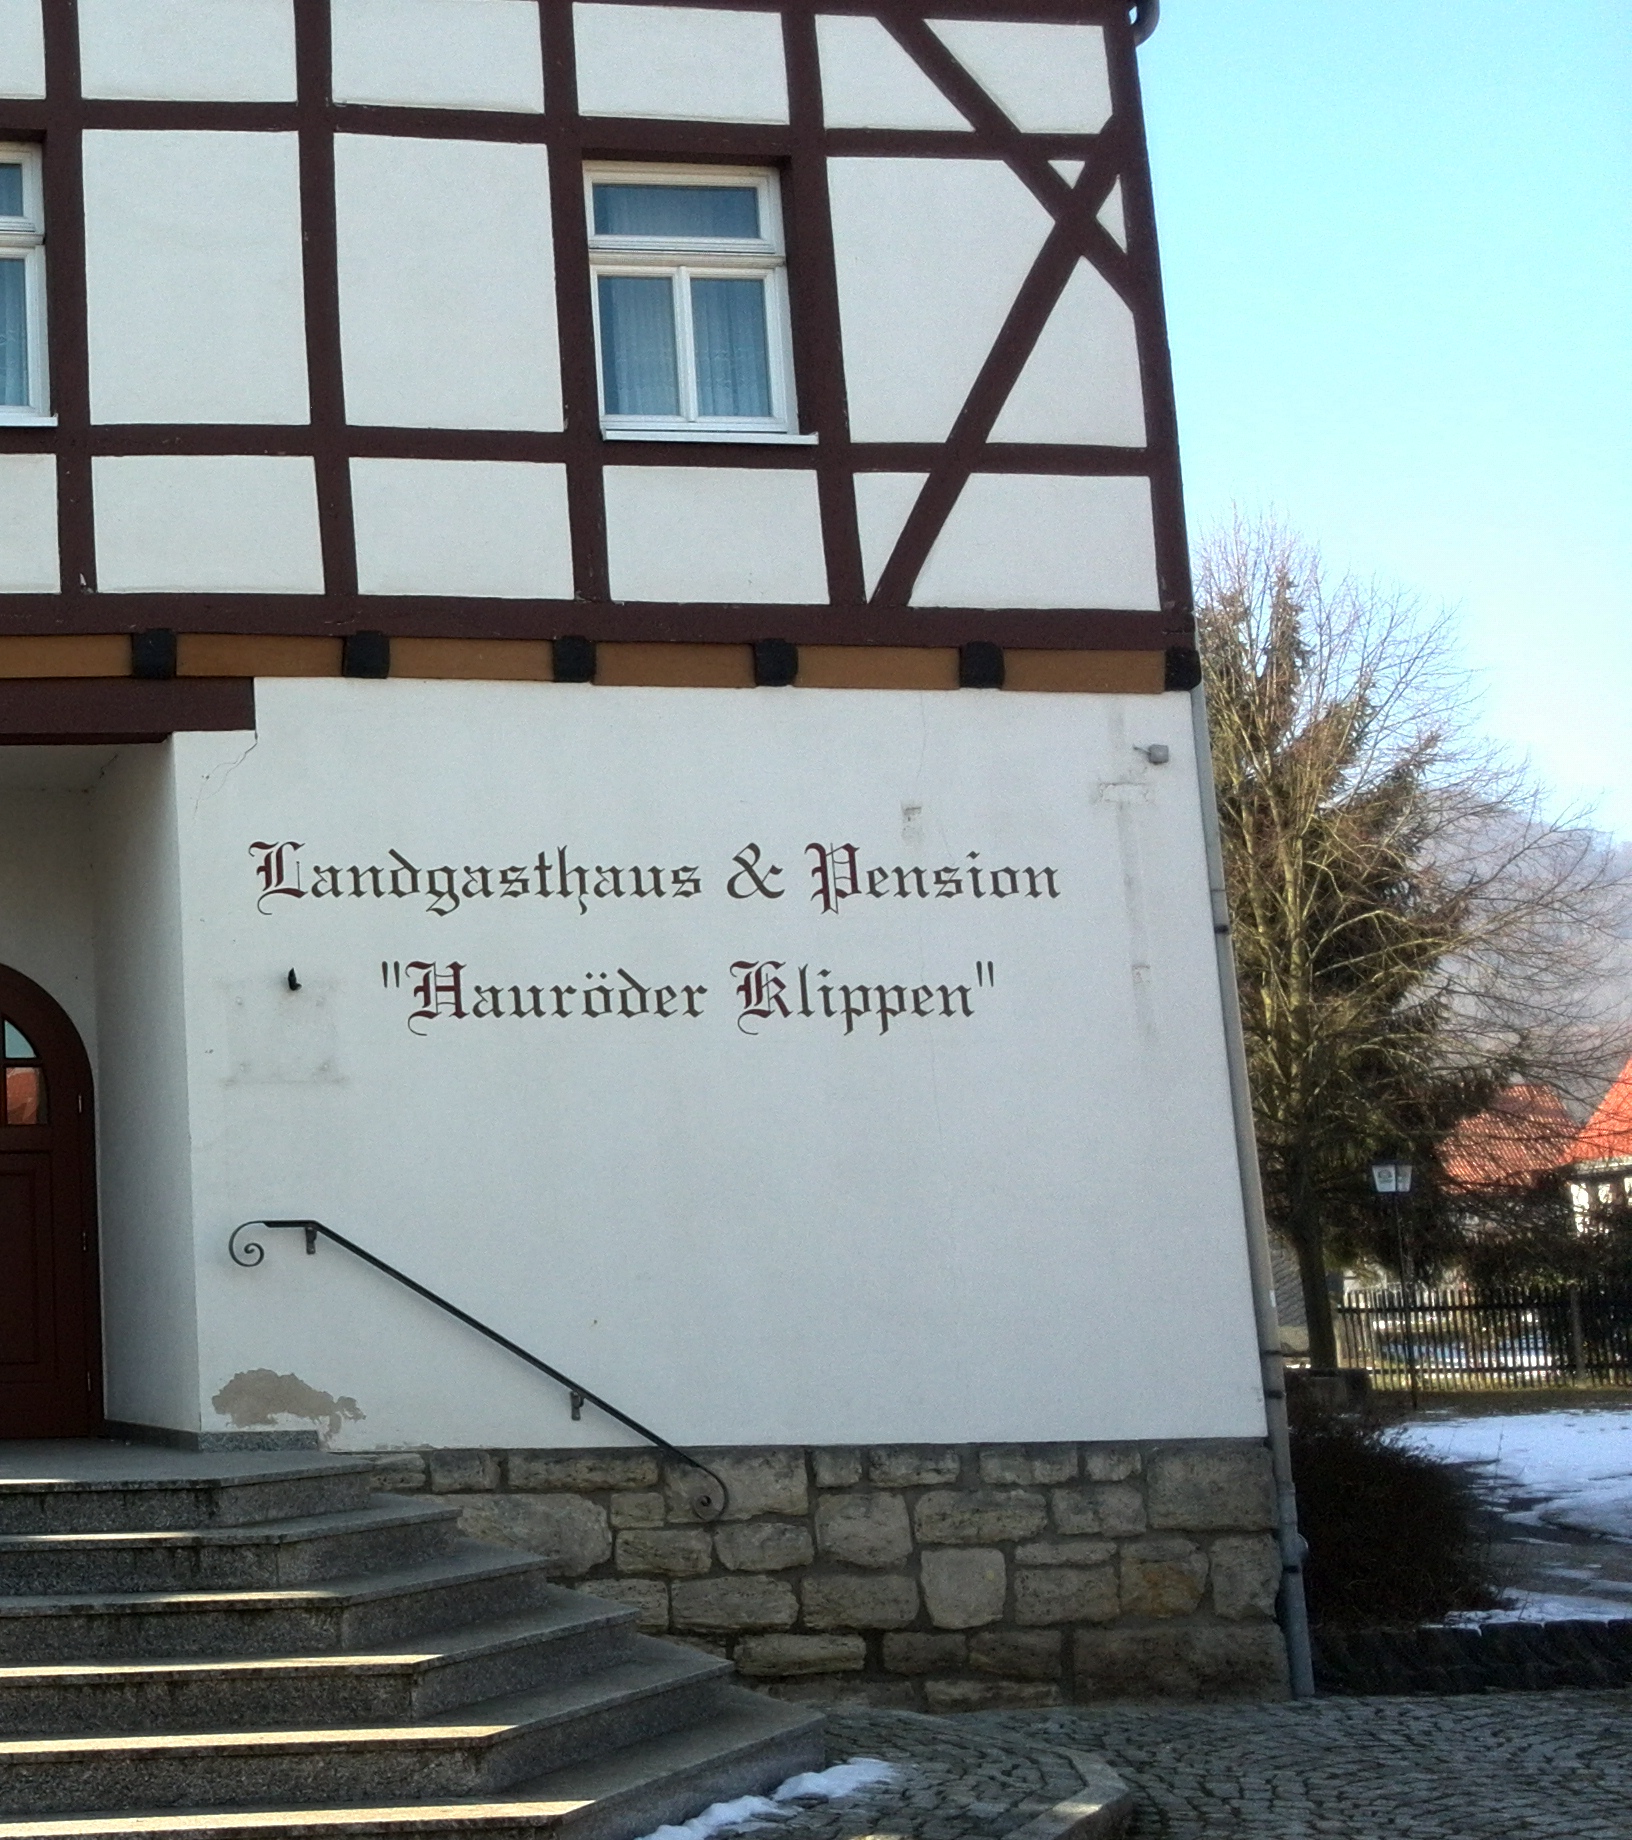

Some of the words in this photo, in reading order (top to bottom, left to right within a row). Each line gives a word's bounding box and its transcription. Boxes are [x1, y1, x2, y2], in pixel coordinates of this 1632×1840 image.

[248, 841, 702, 916] Landgasthaus
[726, 842, 785, 899] &
[804, 842, 1061, 915] Pension
[382, 961, 708, 1036] "Hauröder
[729, 960, 995, 1036] Klippen"
